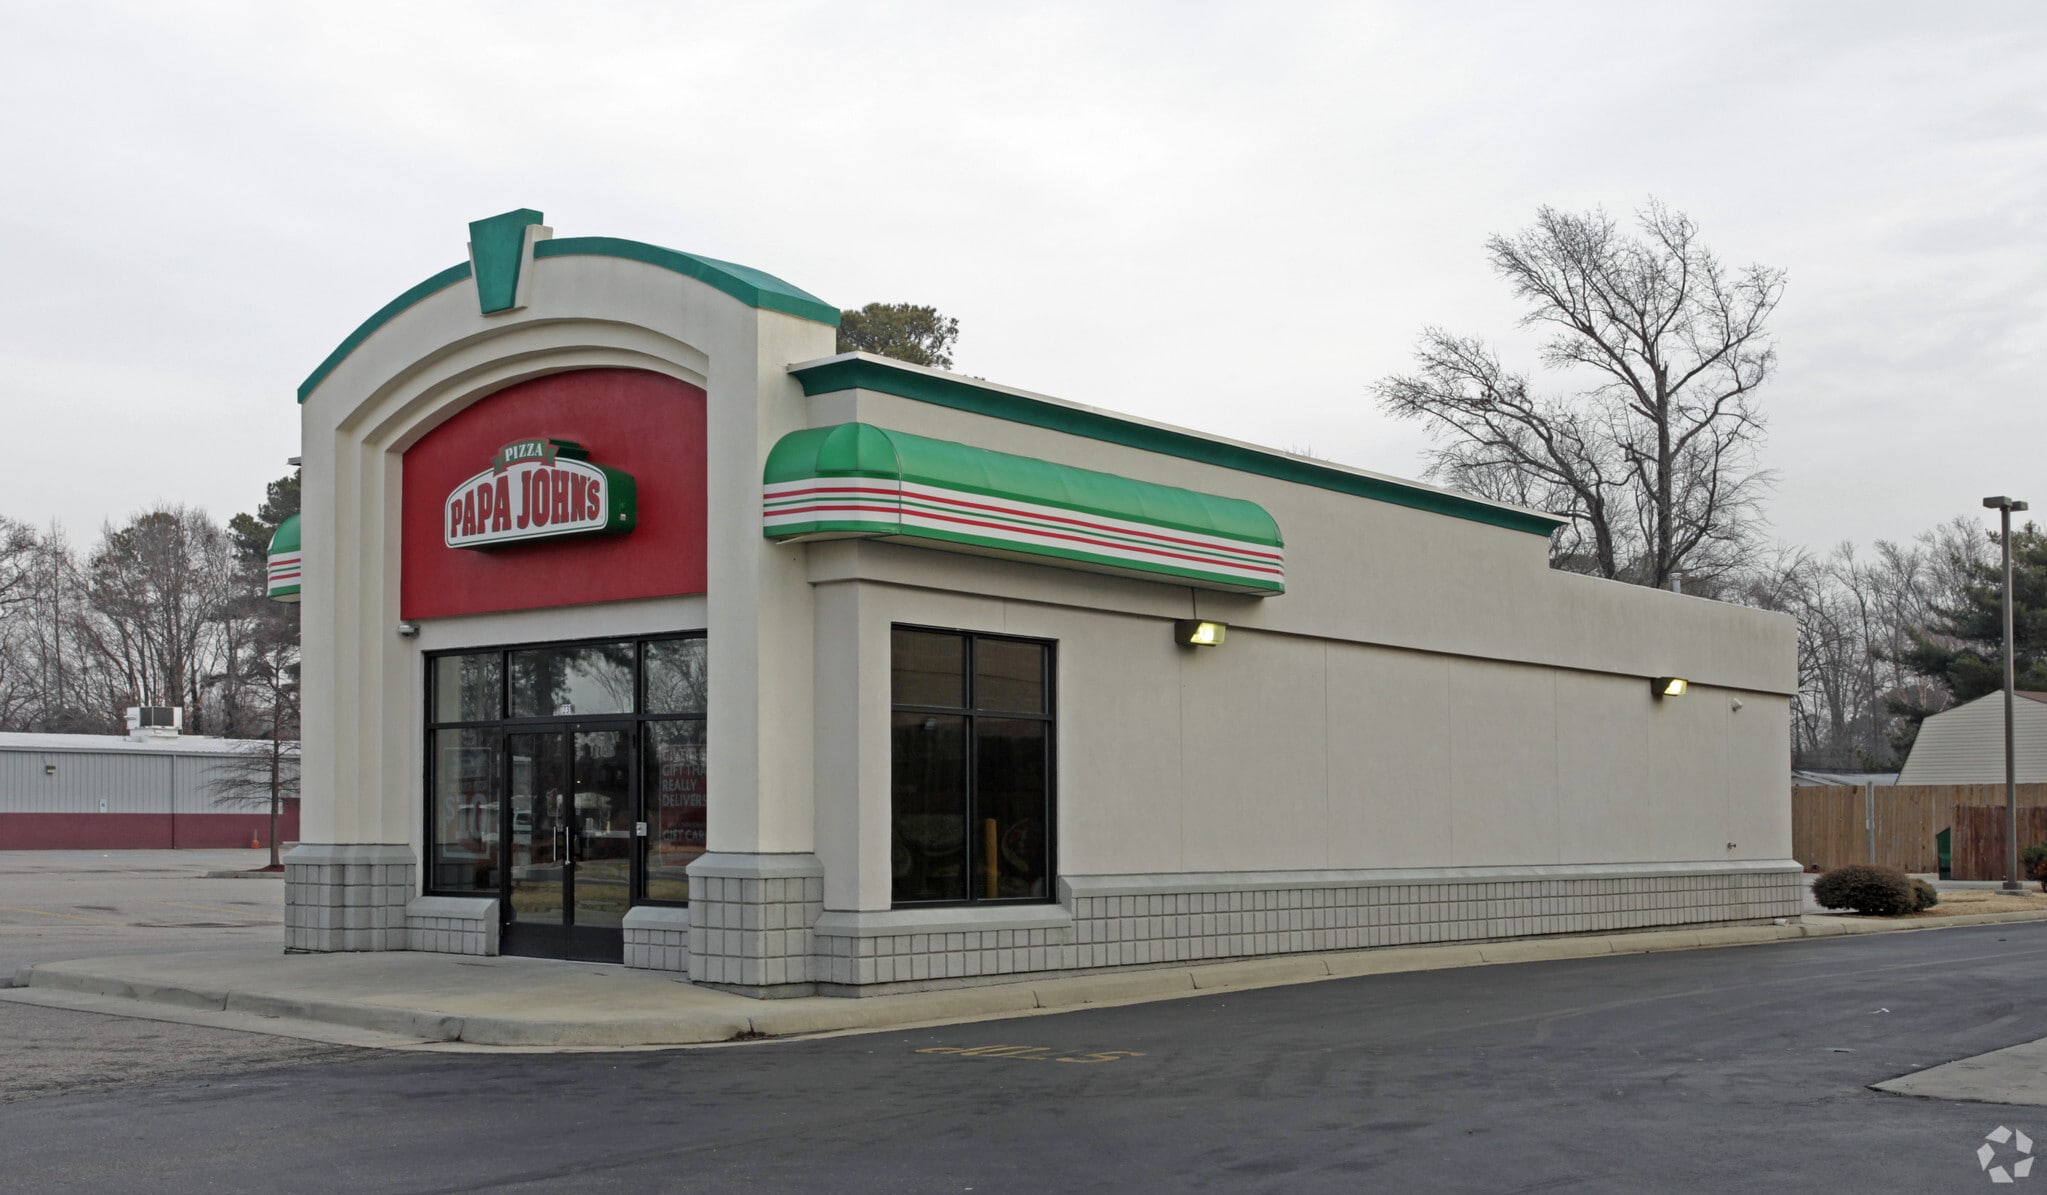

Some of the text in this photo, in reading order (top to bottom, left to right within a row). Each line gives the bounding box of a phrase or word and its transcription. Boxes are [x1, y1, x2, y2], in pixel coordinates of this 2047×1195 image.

[504, 443, 543, 462] PIZZA
[451, 468, 600, 538] PAPA JOHN'S
[663, 764, 707, 776] GIFT THA
[662, 779, 696, 791] REALLY
[445, 793, 490, 840] $10
[663, 829, 707, 841] GIFT CAR
